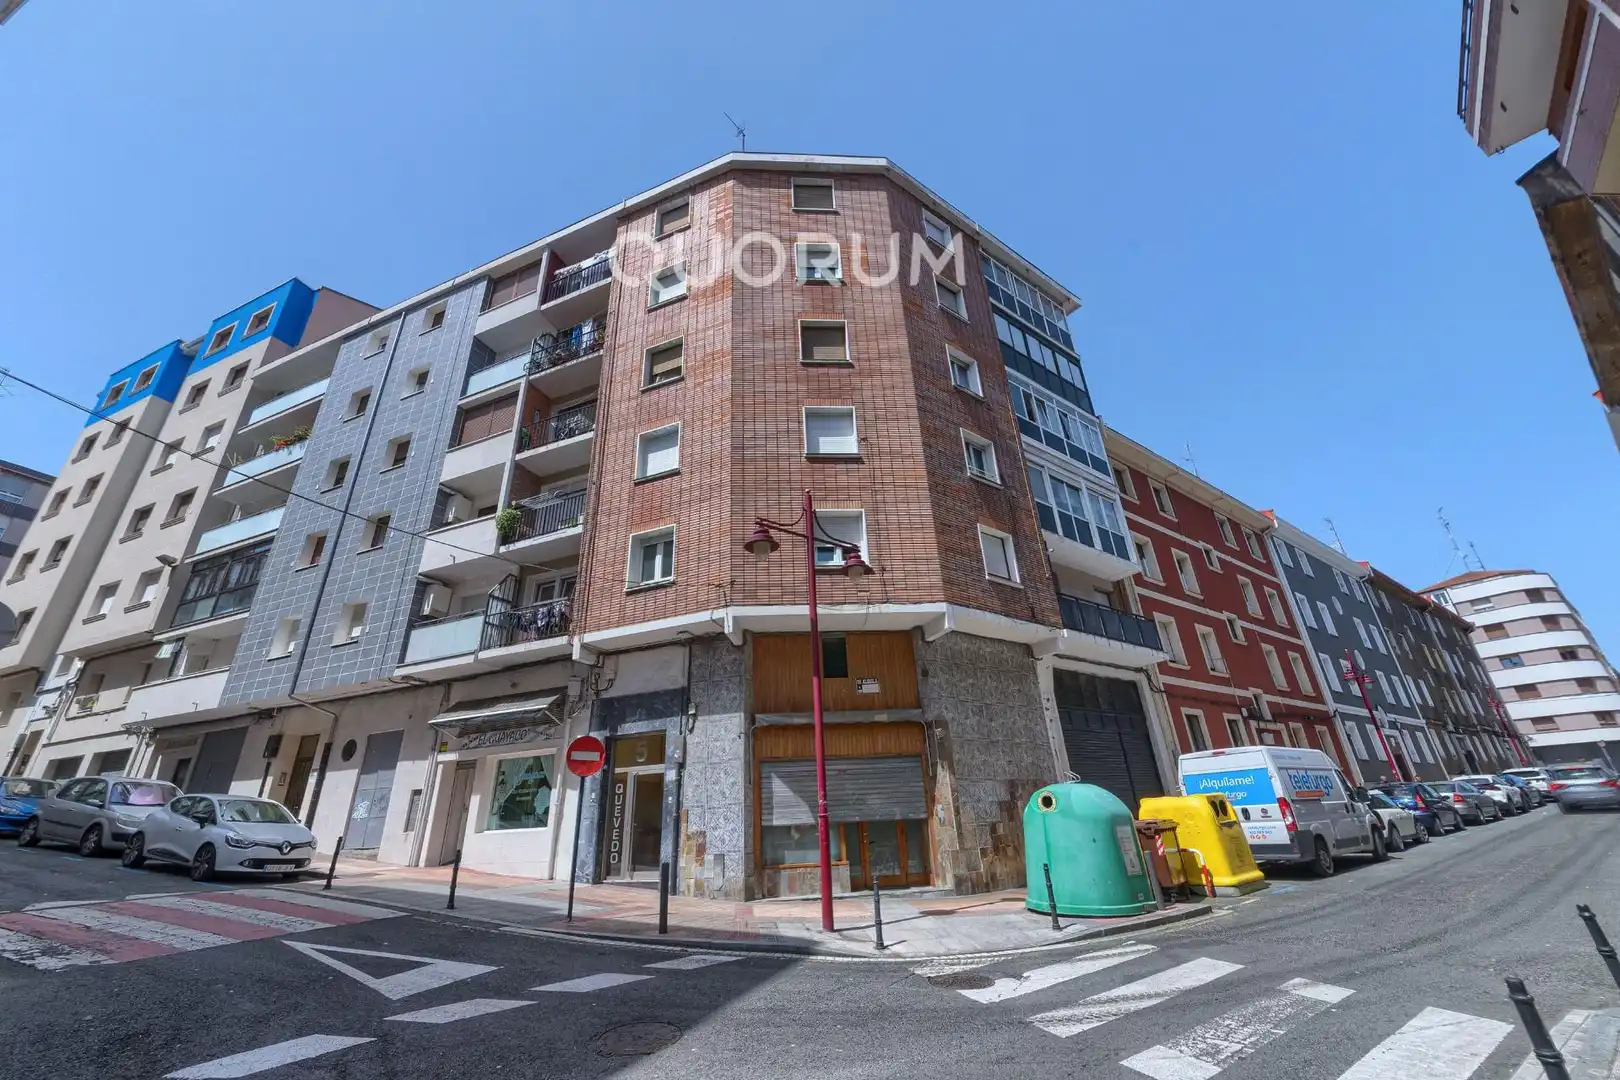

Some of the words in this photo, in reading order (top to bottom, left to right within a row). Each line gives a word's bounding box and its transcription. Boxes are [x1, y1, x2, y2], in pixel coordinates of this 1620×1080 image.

[636, 739, 648, 763] 5
[1286, 768, 1334, 797] telefurgo
[610, 783, 624, 864] QUEVEDO
